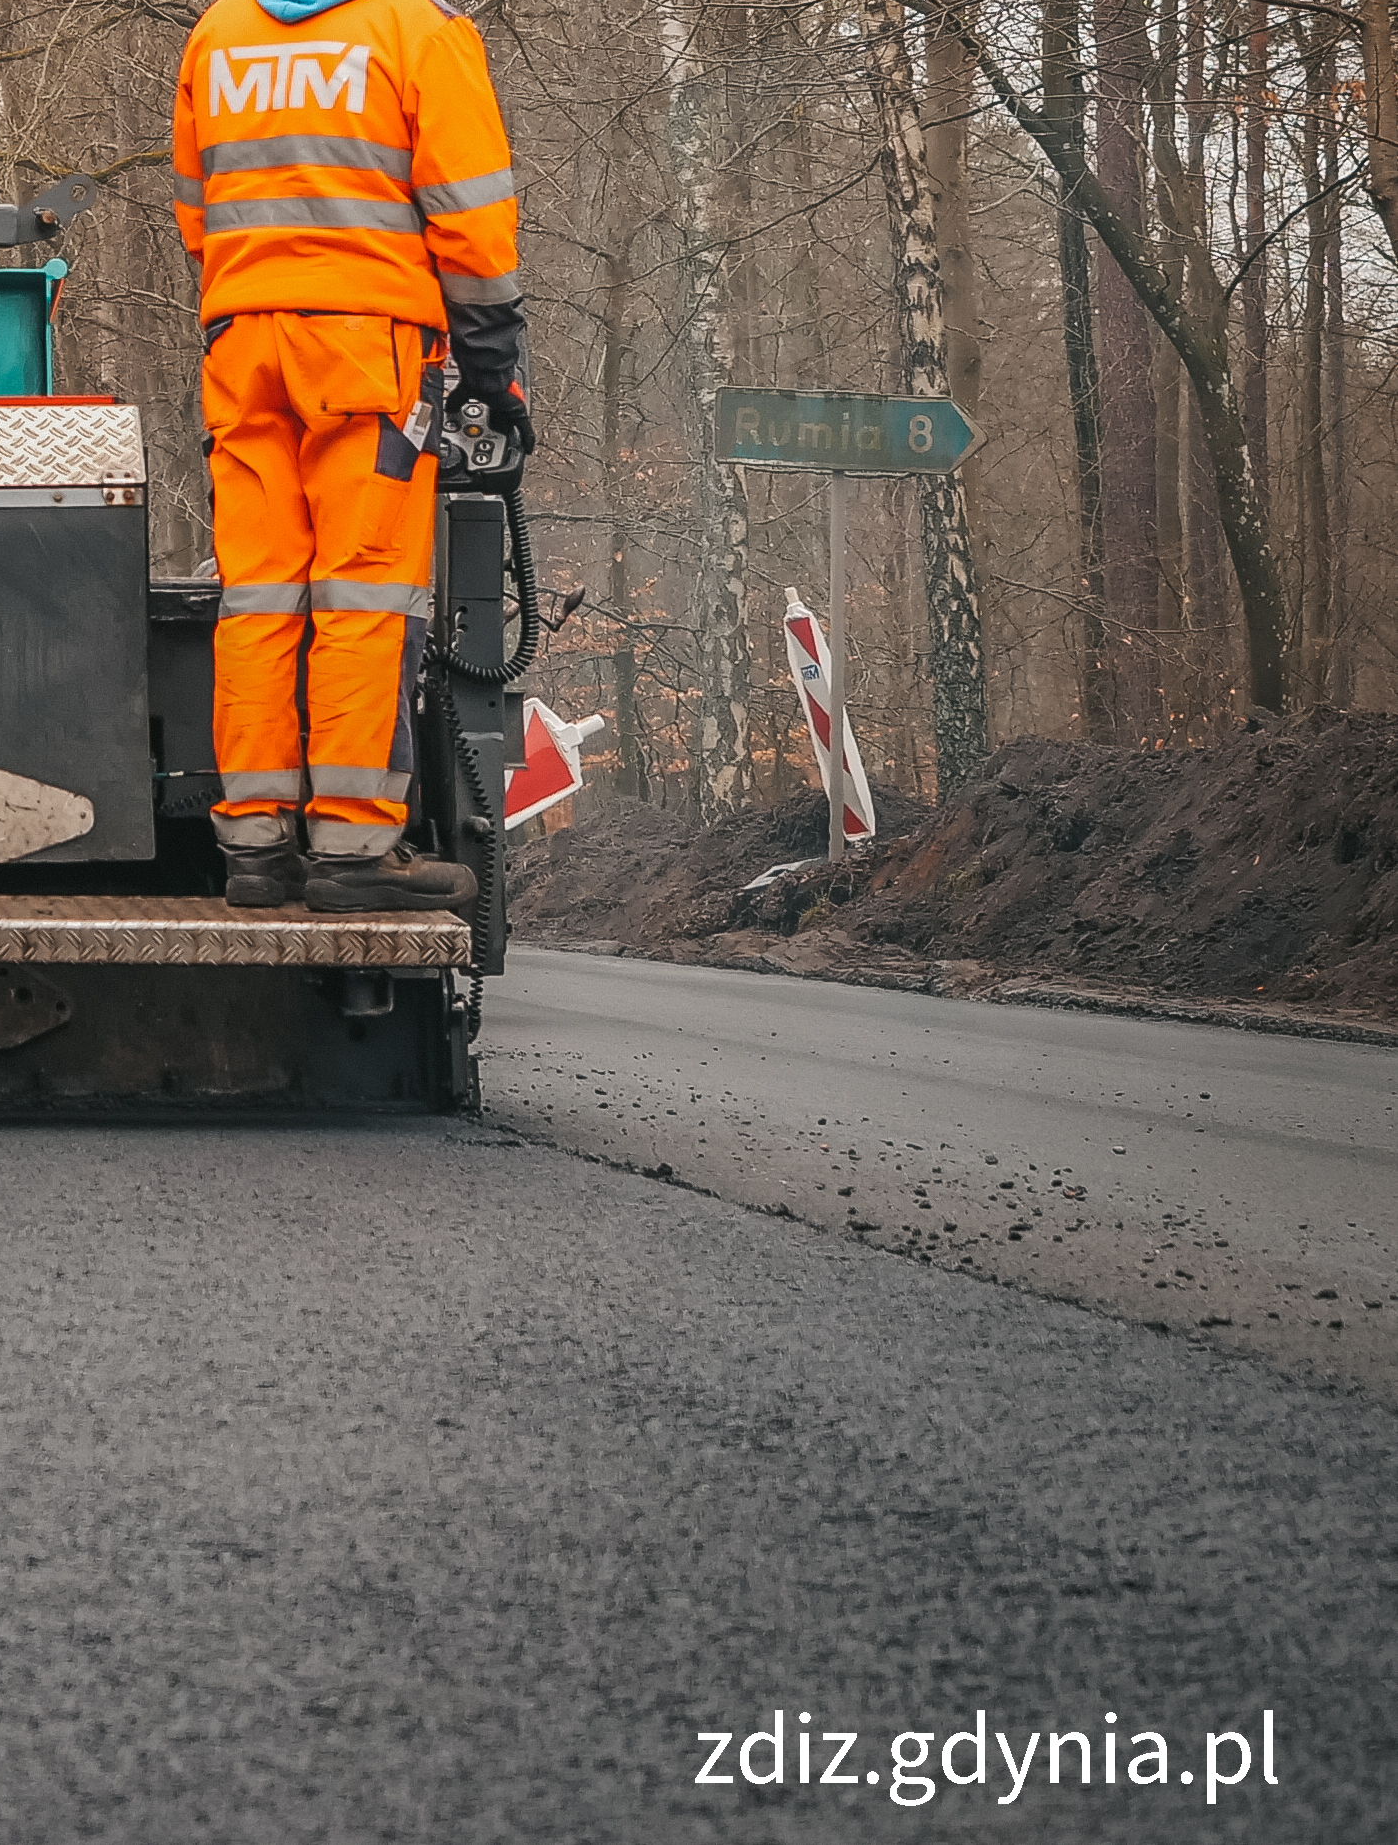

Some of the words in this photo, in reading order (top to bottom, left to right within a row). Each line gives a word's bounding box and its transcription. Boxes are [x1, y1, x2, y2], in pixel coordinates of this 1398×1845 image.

[209, 40, 370, 117] MTM
[735, 406, 882, 450] Rumia
[908, 414, 934, 453] 8
